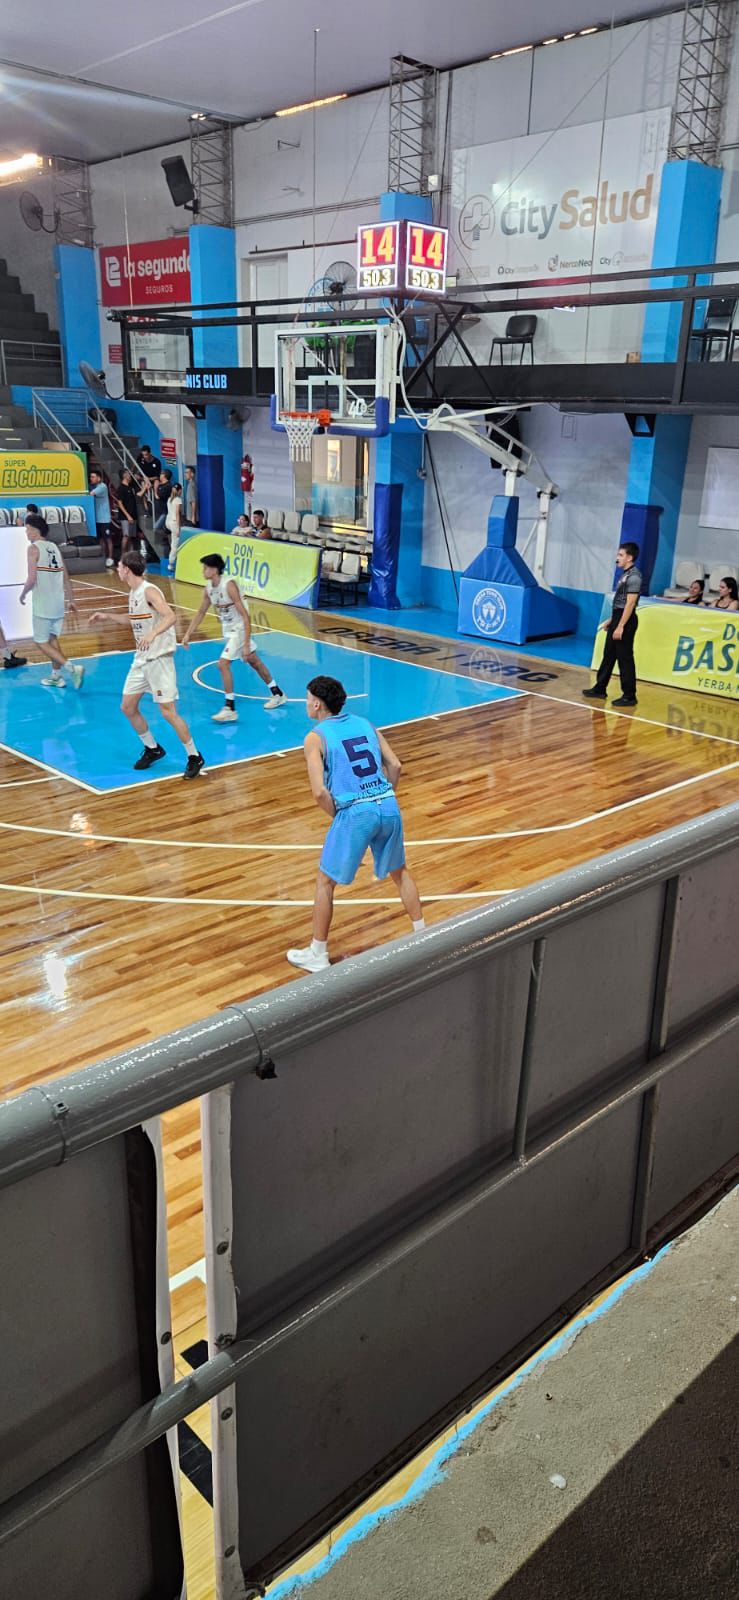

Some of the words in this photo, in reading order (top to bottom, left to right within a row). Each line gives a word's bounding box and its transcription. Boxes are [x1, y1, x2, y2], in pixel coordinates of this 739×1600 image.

[362, 226, 394, 265] 14
[411, 228, 443, 268] 14
[123, 256, 135, 278] la
[145, 284, 173, 294] SEGUROS
[203, 374, 227, 389] CLUB
[2, 469, 17, 488] EL
[18, 465, 70, 488] CÓNDOR
[233, 543, 254, 558] DON
[224, 555, 270, 589] ASILIO
[723, 623, 739, 641] D
[697, 677, 732, 693] YERBA
[341, 735, 379, 778] 5
